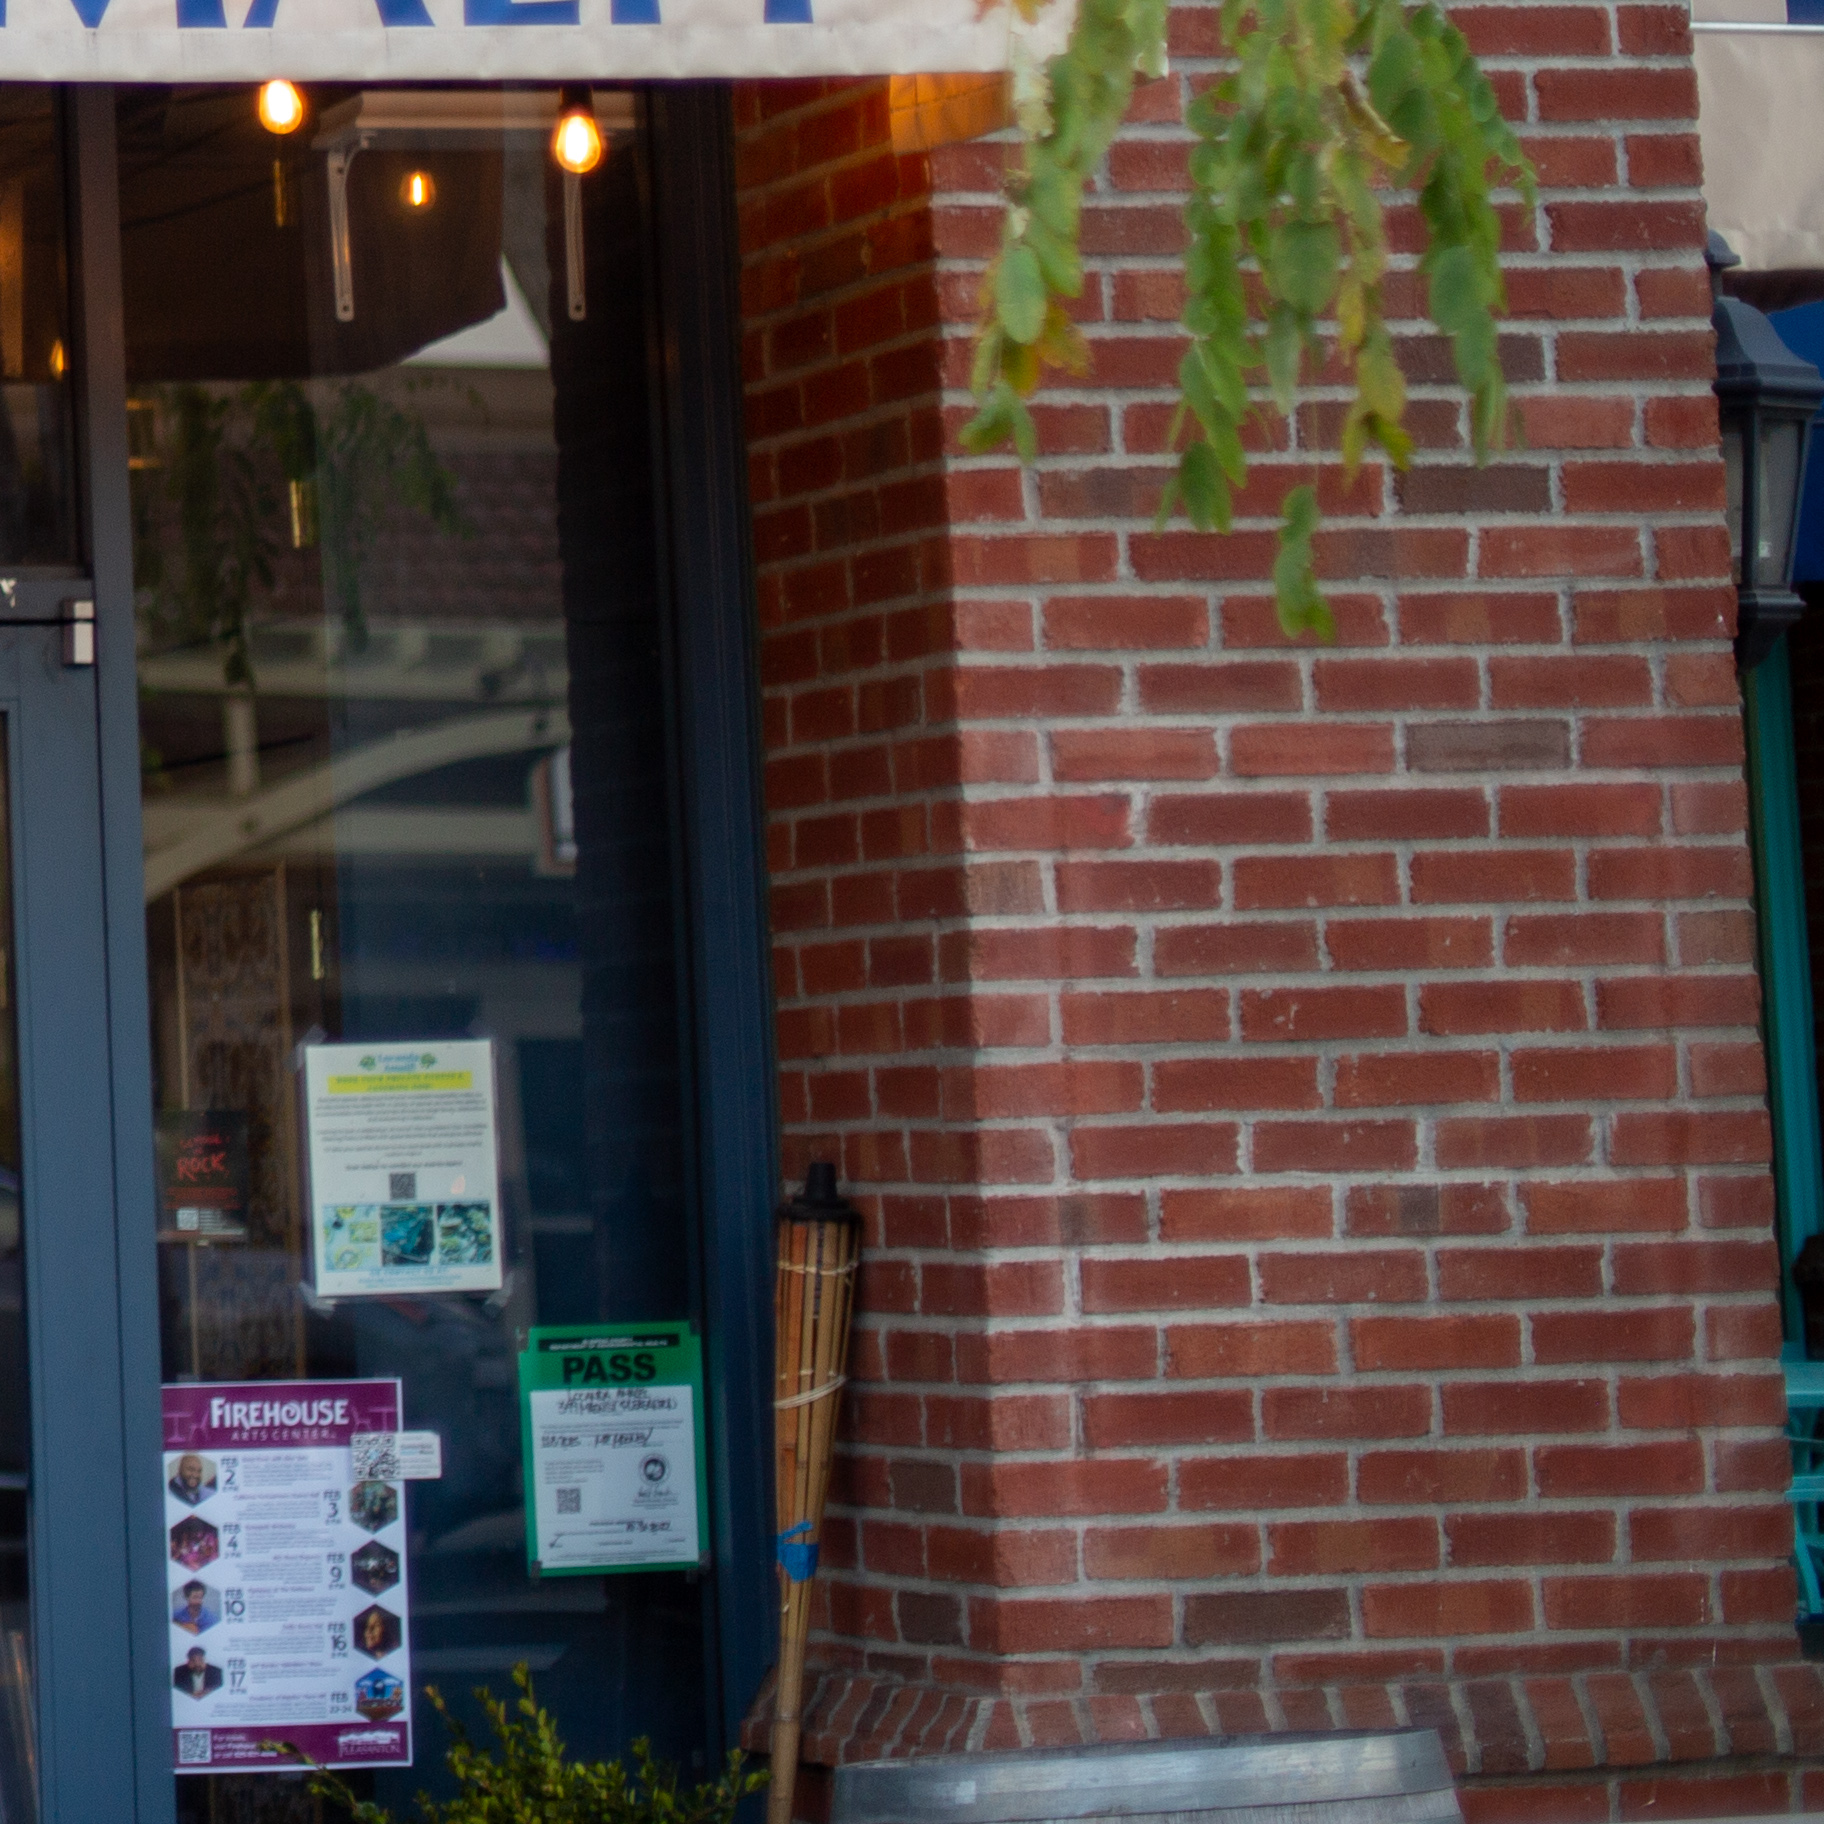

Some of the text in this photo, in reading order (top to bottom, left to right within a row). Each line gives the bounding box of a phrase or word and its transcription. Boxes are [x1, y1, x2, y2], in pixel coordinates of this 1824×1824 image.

[562, 1354, 656, 1384] PASS
[209, 1396, 350, 1430] FIREHOUSE
[231, 1428, 269, 1443] ARTS
[221, 1457, 239, 1468] FEB
[224, 1469, 236, 1486] 2
[323, 1490, 341, 1501] FEB
[329, 1501, 339, 1519] 3
[223, 1524, 241, 1535] FEB
[227, 1534, 238, 1551] 4
[327, 1552, 345, 1563] FEB
[330, 1566, 342, 1584] 9
[225, 1588, 243, 1599] FEB
[225, 1600, 246, 1617] 10
[327, 1622, 346, 1633] FEB
[331, 1634, 347, 1651] 16
[227, 1658, 246, 1669] FEB
[230, 1671, 246, 1687] 17
[331, 1692, 348, 1703] FEB
